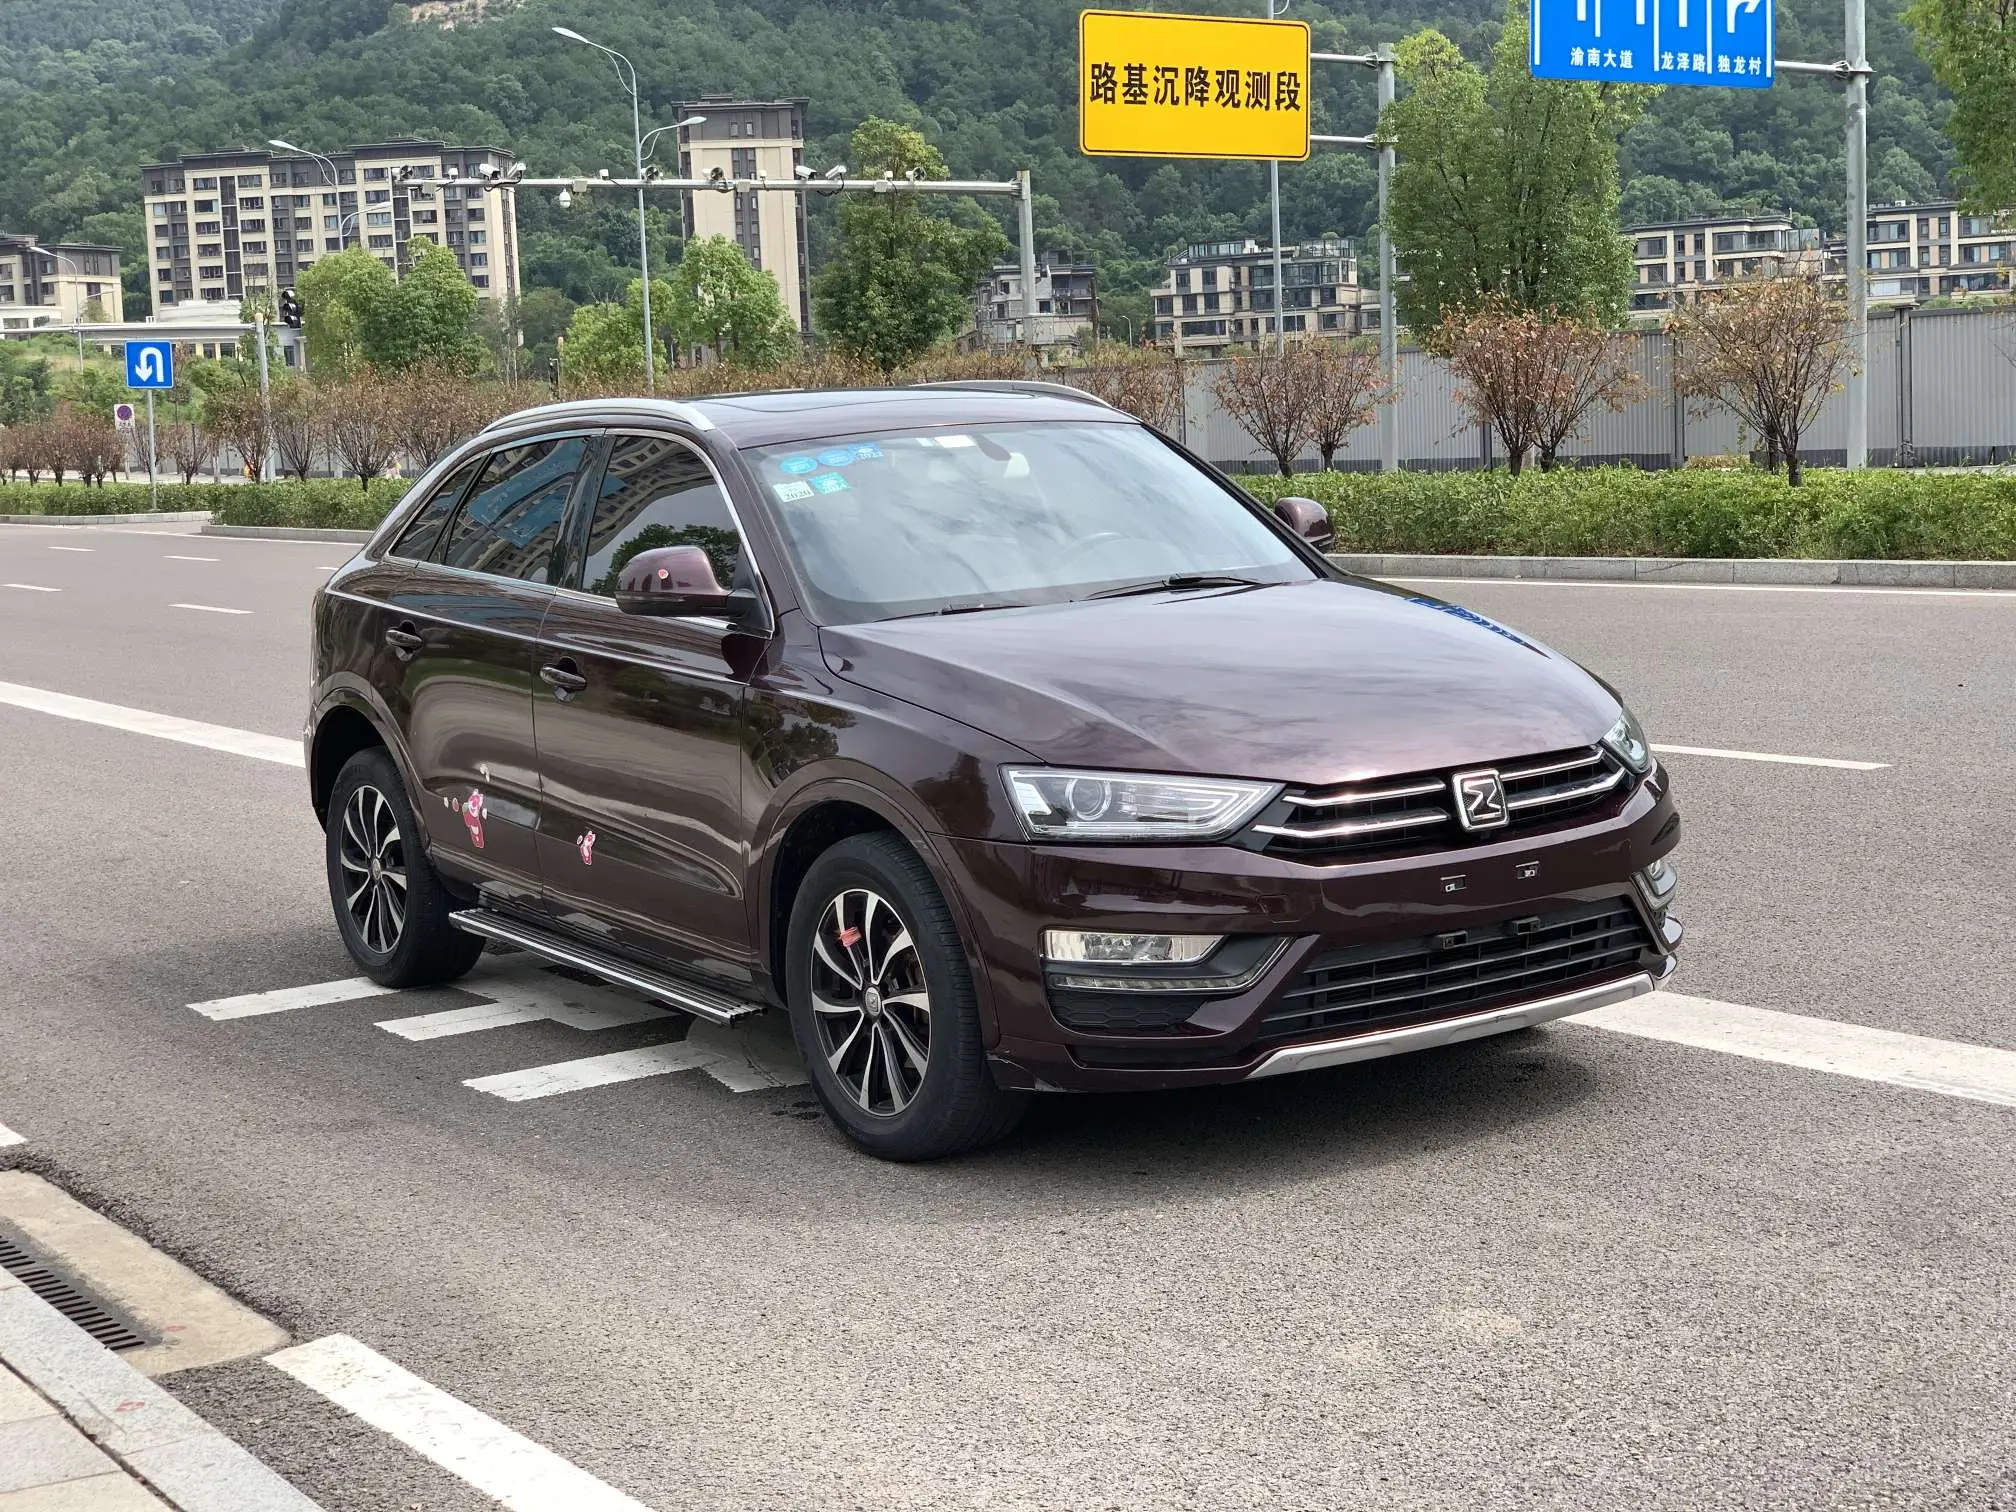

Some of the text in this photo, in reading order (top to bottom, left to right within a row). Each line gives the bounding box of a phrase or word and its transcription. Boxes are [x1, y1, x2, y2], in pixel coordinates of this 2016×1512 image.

[1570, 46, 1634, 69] 渝南大道
[1660, 51, 1706, 73] 龙泽路
[1717, 54, 1762, 76] 独龙村
[1090, 61, 1301, 112] 路基沉降观测段
